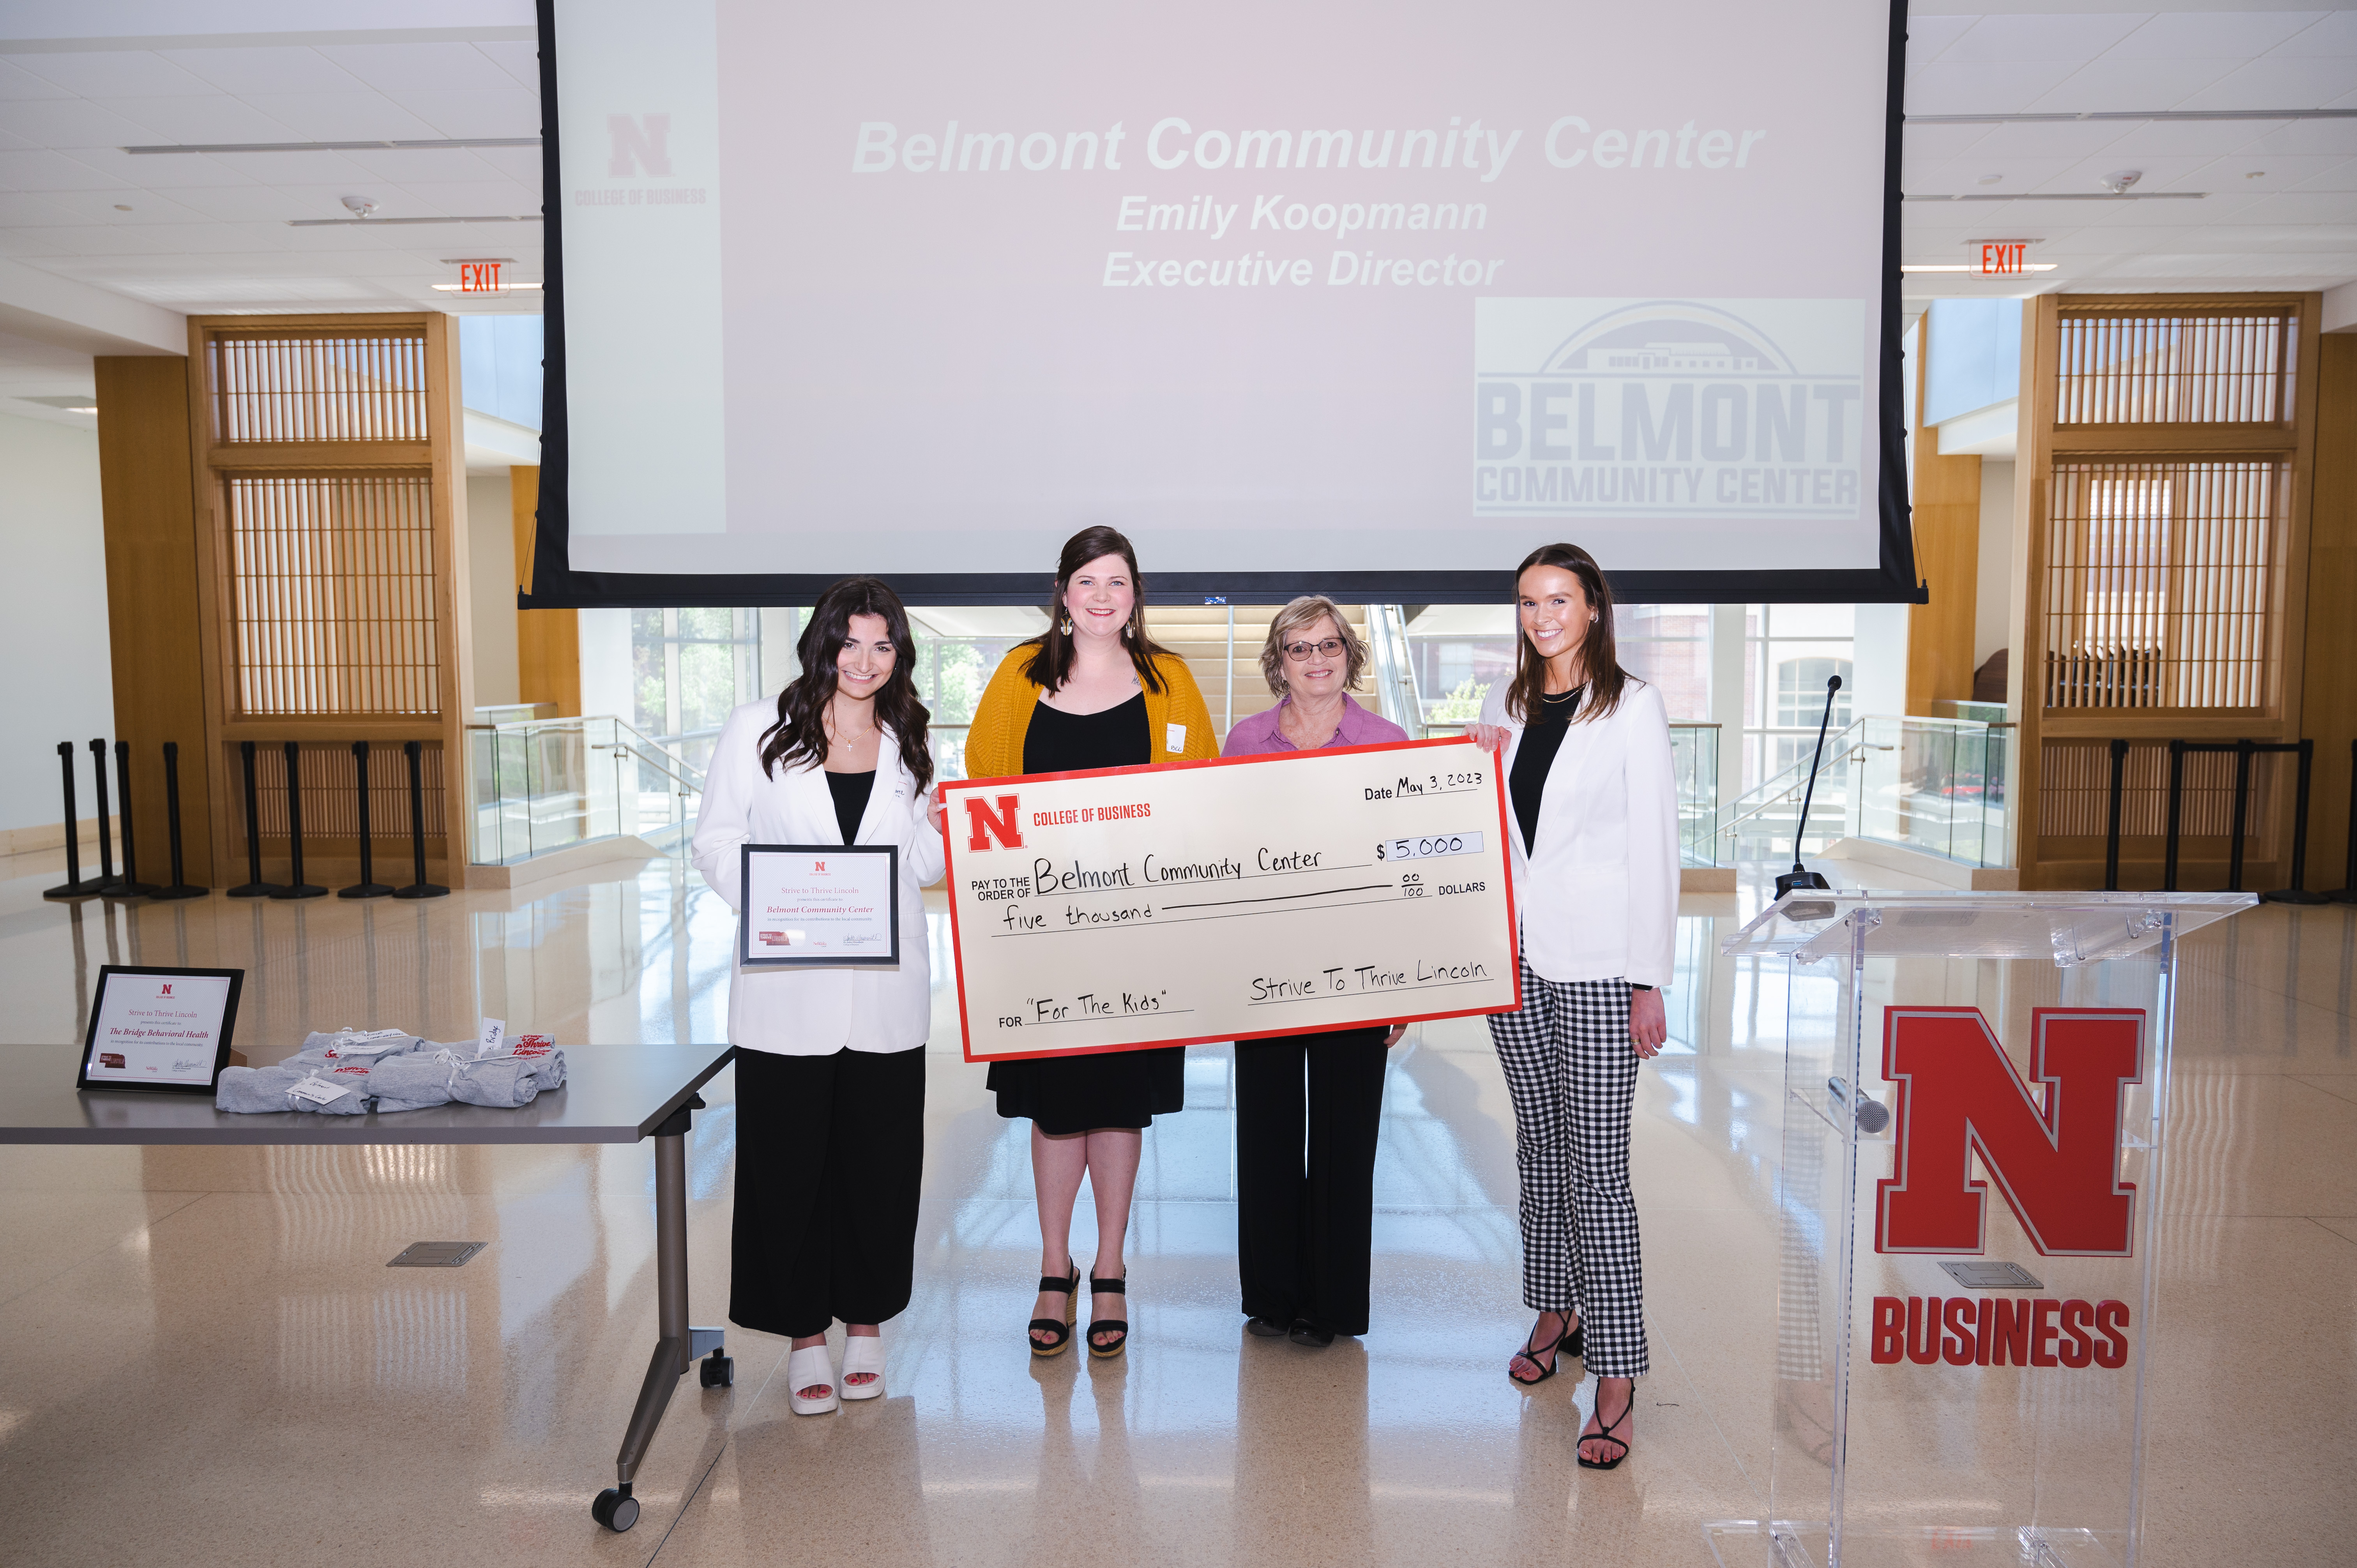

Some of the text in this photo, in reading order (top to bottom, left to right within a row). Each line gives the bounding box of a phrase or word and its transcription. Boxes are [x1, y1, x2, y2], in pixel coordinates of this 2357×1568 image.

[607, 113, 671, 178] N
[852, 116, 1765, 182] Belmont Community Center
[575, 188, 706, 206] COLLEGE OF BUSINESS
[1116, 195, 1487, 239] Emily Koopmann
[1103, 250, 1505, 286] Executive Director
[1982, 244, 2026, 274] EXIT
[461, 264, 501, 291] EXIT
[1477, 382, 1861, 463] BELMONT
[1476, 466, 1858, 504] COMMUNITY CENTER
[1365, 788, 1392, 800] Date
[1397, 773, 1482, 797] May 3, 2023
[964, 793, 1024, 853] N
[1034, 803, 1151, 826] COLLEGE OF BUSINESS
[1377, 844, 1385, 861] $
[1396, 837, 1462, 858] 5,000
[815, 862, 825, 871] N
[1034, 848, 1322, 895] Belmont Community Center
[972, 877, 1030, 890] PAY TO THE
[1404, 887, 1423, 897] 100
[1439, 882, 1486, 895] DOLLARS
[978, 888, 1031, 901] ORDER OF
[801, 906, 846, 915] Community
[1003, 903, 1152, 930] five thousand
[162, 984, 172, 994] N
[1250, 959, 1488, 1000] Strive To Thrive Lincoln
[1078, 994, 1114, 1014] The
[999, 1016, 1023, 1028] FOR
[123, 1028, 146, 1038] Bridge
[147, 1029, 186, 1037] Behavioral
[486, 1026, 501, 1044] Bridge
[523, 1037, 551, 1048] Thrive
[293, 1088, 315, 1097] Community
[309, 1081, 330, 1089] Belmont
[1874, 1005, 2146, 1257] N
[1871, 1296, 2129, 1368] BUSINESS
